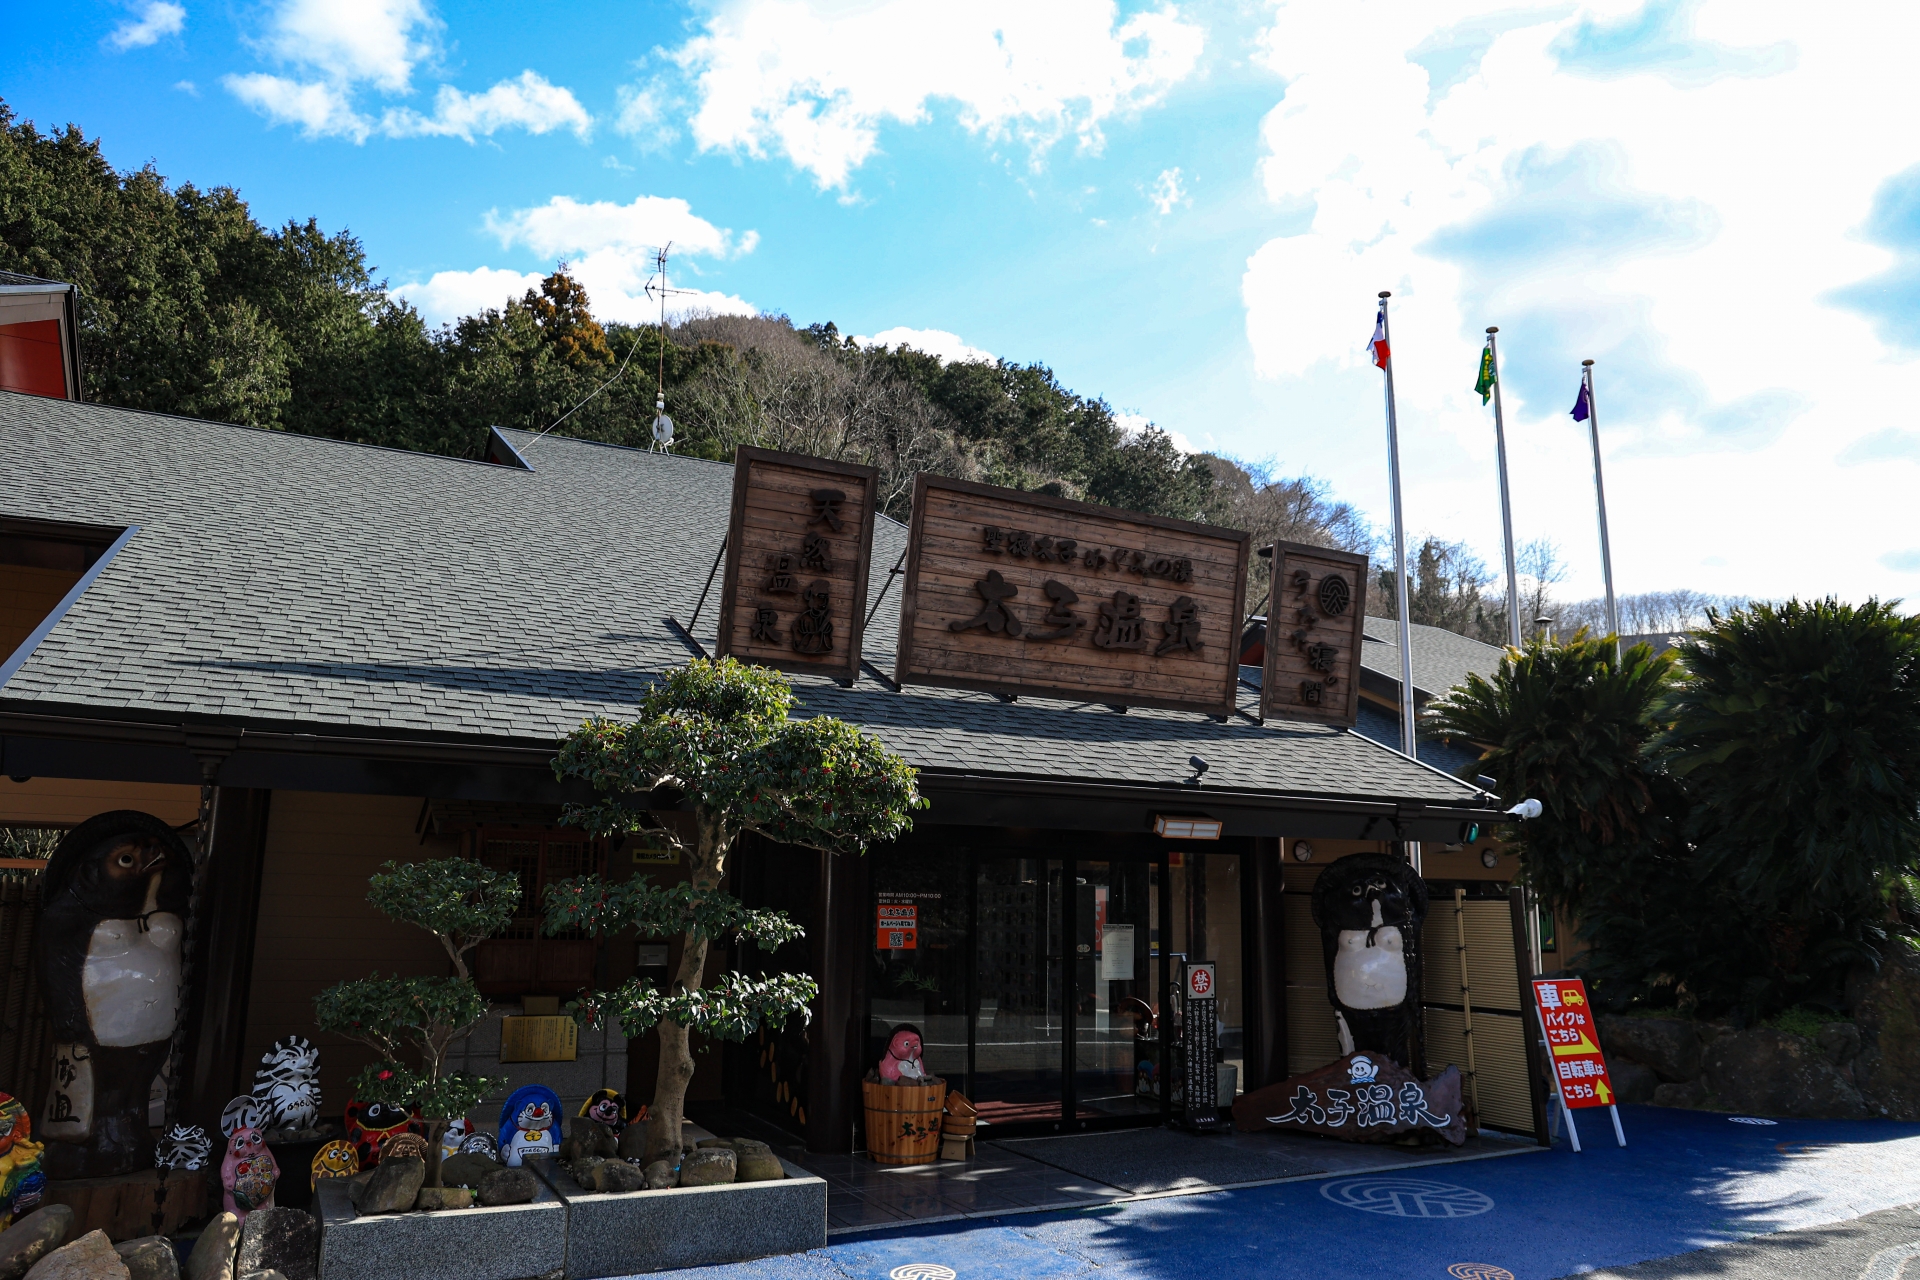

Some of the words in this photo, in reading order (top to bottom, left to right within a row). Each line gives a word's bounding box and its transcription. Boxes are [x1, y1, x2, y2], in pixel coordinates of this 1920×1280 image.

[800, 488, 846, 572] 天然
[983, 526, 1193, 582] 聖徳太子めぐみの湯
[750, 554, 799, 643] 温泉
[949, 569, 1205, 657] 太子温泉
[1194, 971, 1209, 991] 禁
[1536, 983, 1562, 1011] 車
[1546, 1012, 1586, 1027] バイクは
[1549, 1028, 1579, 1043] こちら
[1557, 1059, 1605, 1079] 自転車は
[1265, 1081, 1452, 1128] 太子温泉
[1564, 1084, 1594, 1100] こちら
